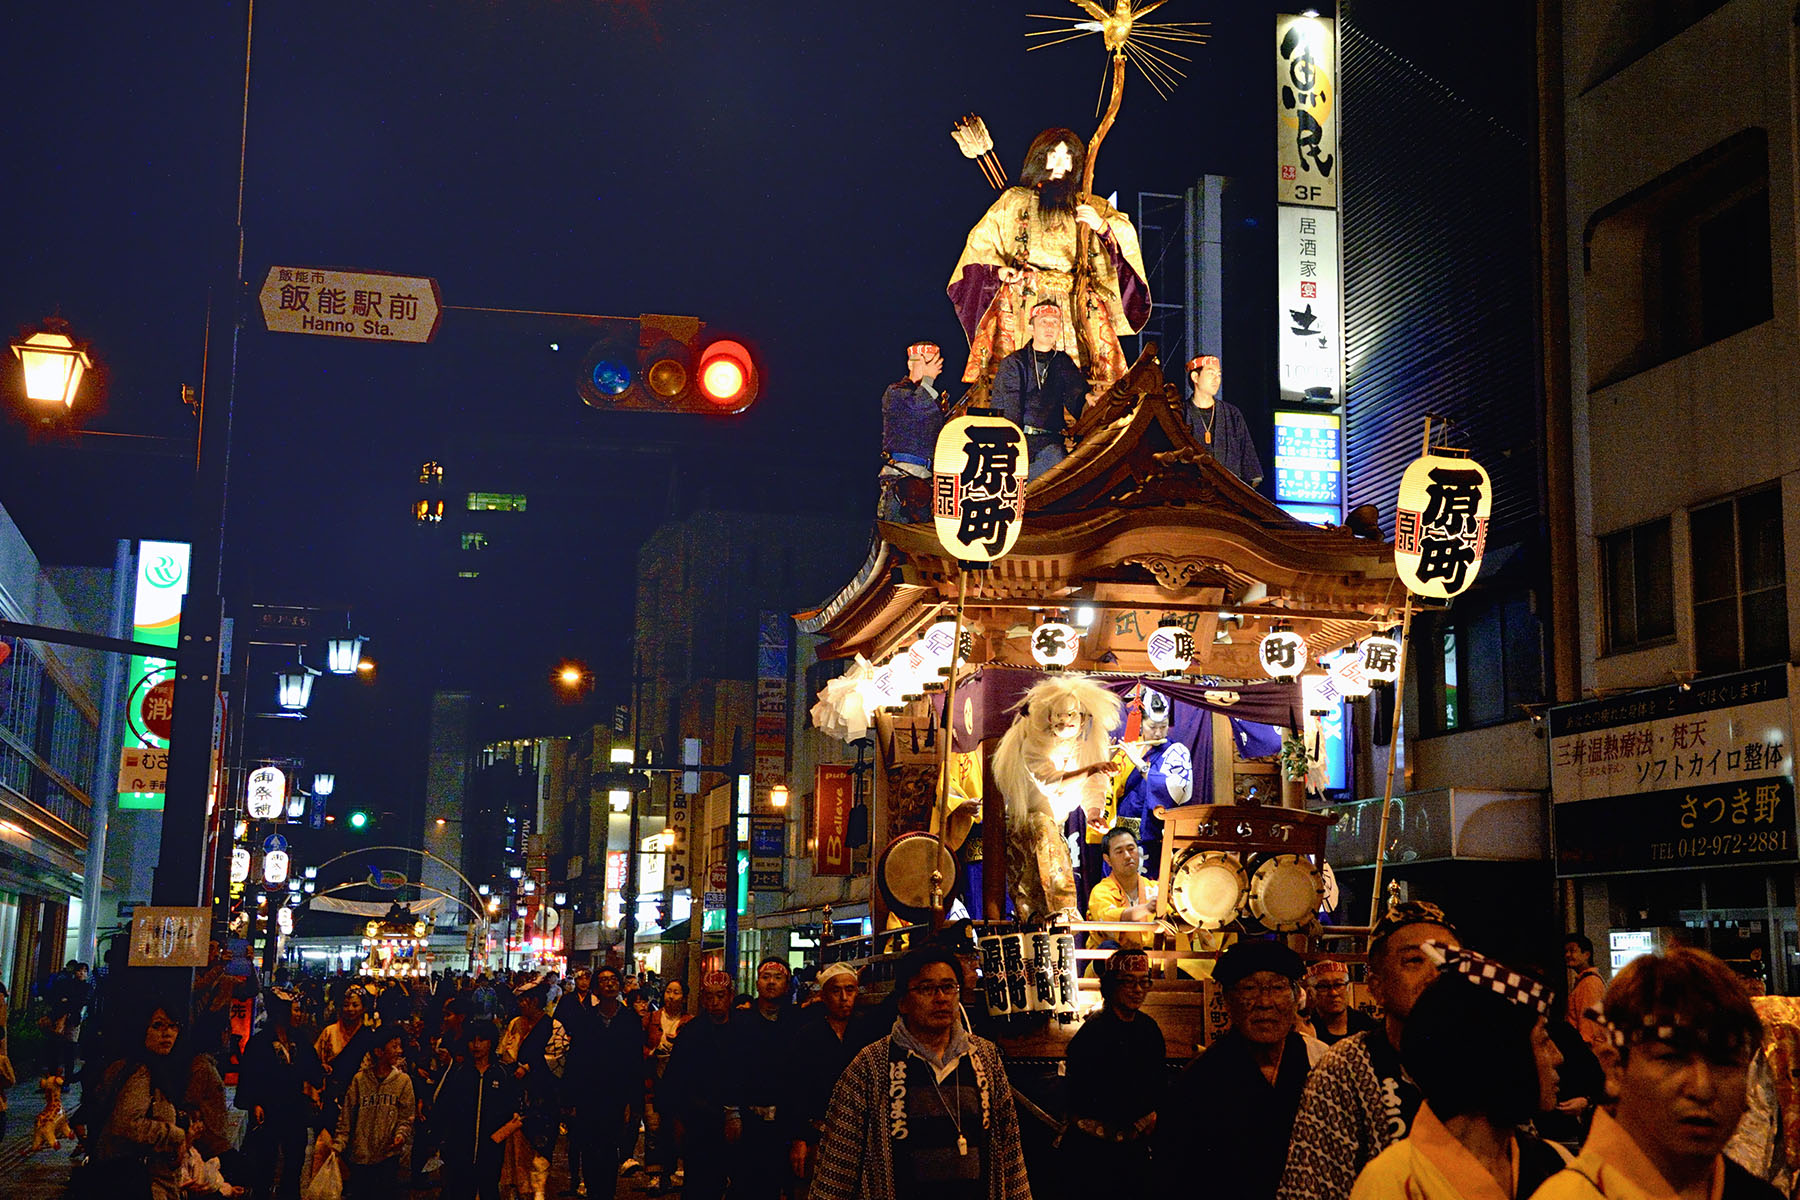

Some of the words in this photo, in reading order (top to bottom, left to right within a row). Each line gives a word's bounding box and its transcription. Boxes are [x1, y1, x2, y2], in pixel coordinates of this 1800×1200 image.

[1295, 185, 1321, 200] 3F
[1299, 217, 1317, 277] 居酒家
[279, 269, 325, 284] 飯能市
[279, 284, 419, 321] 飯能駅前
[302, 315, 355, 333] Hanno
[363, 320, 394, 336] Sta.
[957, 425, 1021, 557] 原町
[1415, 466, 1485, 594] 原町
[1265, 637, 1297, 668] 町
[1637, 742, 1784, 785] ソフトカイロ整体
[1680, 783, 1782, 829] さつき野
[1651, 843, 1674, 861] TEL
[1678, 830, 1788, 859] 042-972-2881
[889, 1060, 909, 1140] はらまち
